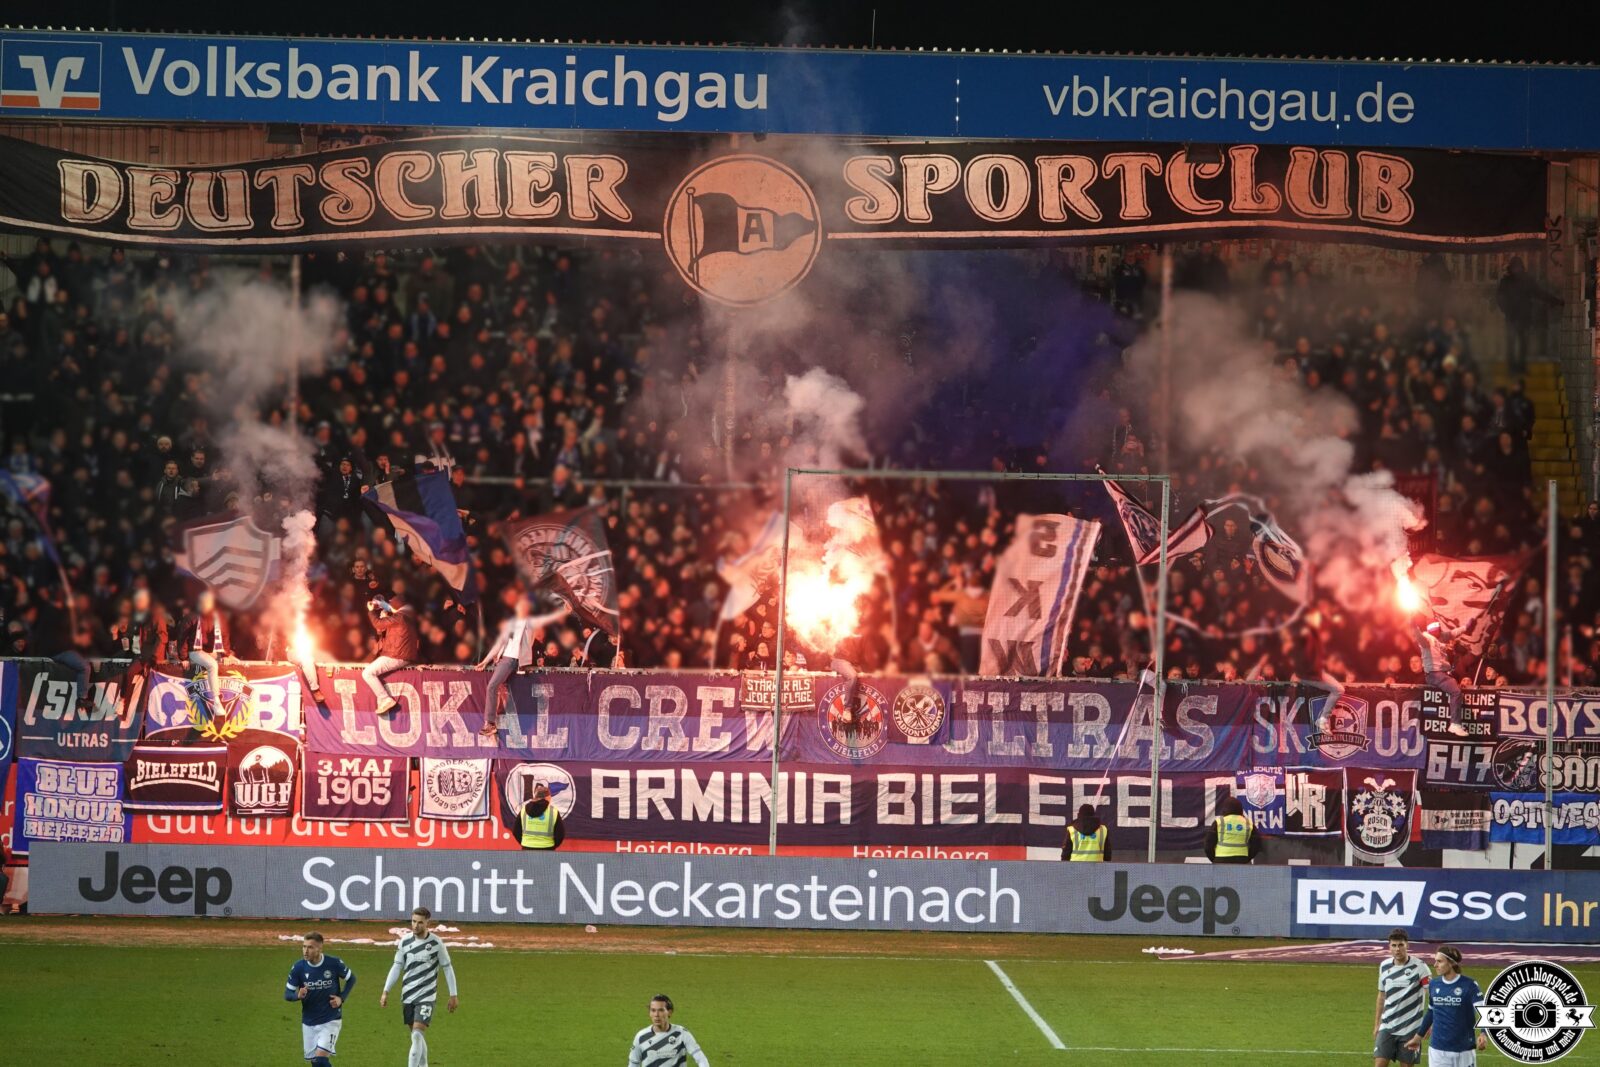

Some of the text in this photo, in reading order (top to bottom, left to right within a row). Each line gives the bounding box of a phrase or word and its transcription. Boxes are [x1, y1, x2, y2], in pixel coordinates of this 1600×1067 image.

[122, 47, 768, 121] Volksbank Kraichgau
[1042, 76, 1415, 131] vbkraichgau.de
[57, 145, 1415, 231] DEUTSCHER SPORTCLUB
[742, 213, 768, 243] A
[745, 691, 769, 703] JEDE
[1424, 690, 1443, 704] DIE
[57, 732, 109, 748] ULTRAS
[1251, 696, 1425, 757] SK 05
[1424, 719, 1447, 732] DER
[832, 742, 879, 758] BIELEFELD
[1426, 743, 1494, 782] 647
[36, 763, 119, 799] BLUE
[135, 759, 218, 782] BIELEFELD
[317, 777, 392, 806] 1905
[591, 768, 1239, 829] ARMINIA BIELEFELD
[24, 793, 125, 826] HONOUR
[24, 818, 125, 843] BIELEFELD
[78, 851, 1240, 935] Jeep Schmitt Neckarsteinach Jeep
[1310, 889, 1405, 917] HCM
[1430, 890, 1527, 921] SSC
[419, 1004, 433, 1018] 23
